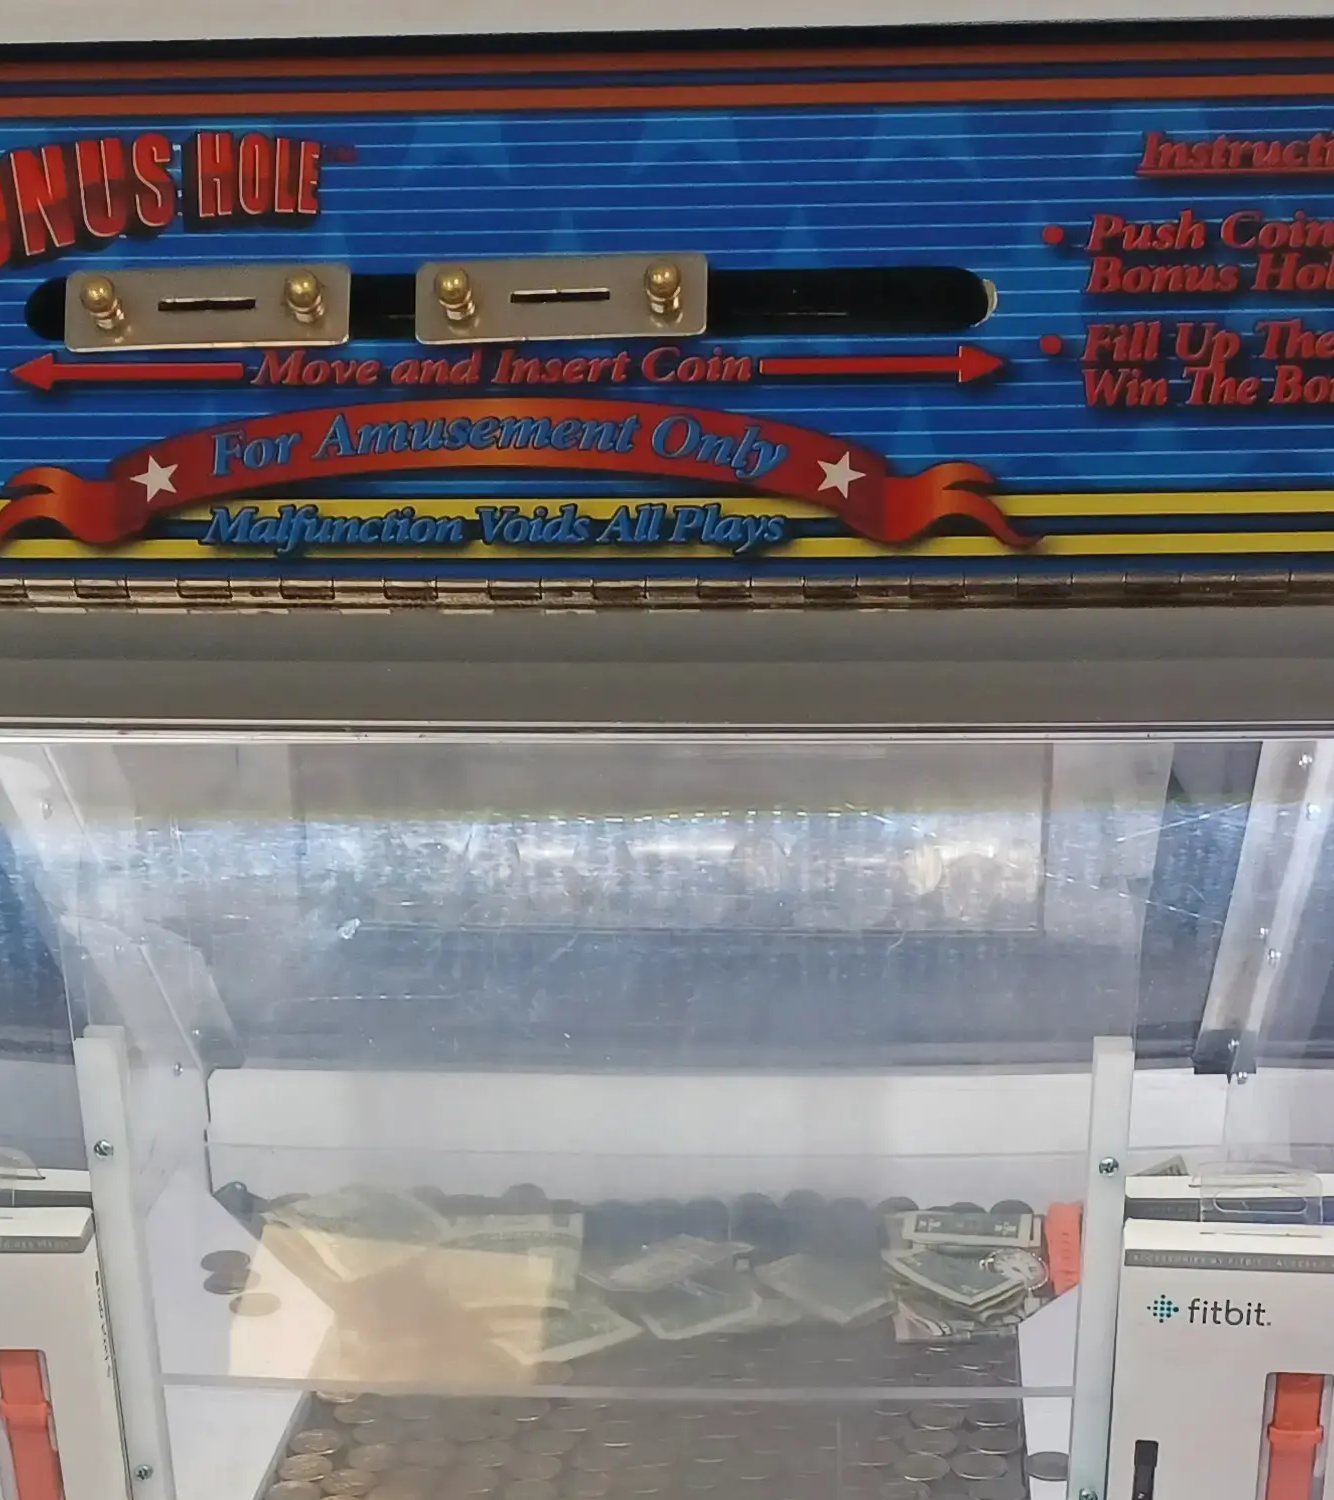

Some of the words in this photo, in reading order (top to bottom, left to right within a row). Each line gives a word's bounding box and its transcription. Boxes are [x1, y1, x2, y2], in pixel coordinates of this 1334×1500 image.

[195, 131, 323, 220] HOLE
[1085, 209, 1207, 252] Push
[1083, 254, 1240, 295] Bonus
[250, 348, 382, 387] Move
[390, 348, 480, 386] and
[490, 348, 635, 386] Insert
[640, 346, 753, 383] Coin
[1080, 320, 1161, 364] Fill
[1173, 322, 1241, 371] Up
[1081, 367, 1169, 408] Win
[1181, 364, 1262, 407] The
[209, 429, 301, 479] For
[311, 412, 642, 461] Amusement
[650, 414, 791, 480] Only
[202, 503, 465, 556] Malfunction
[474, 503, 590, 546] Voids
[596, 504, 668, 545] All
[668, 503, 787, 556] Plays
